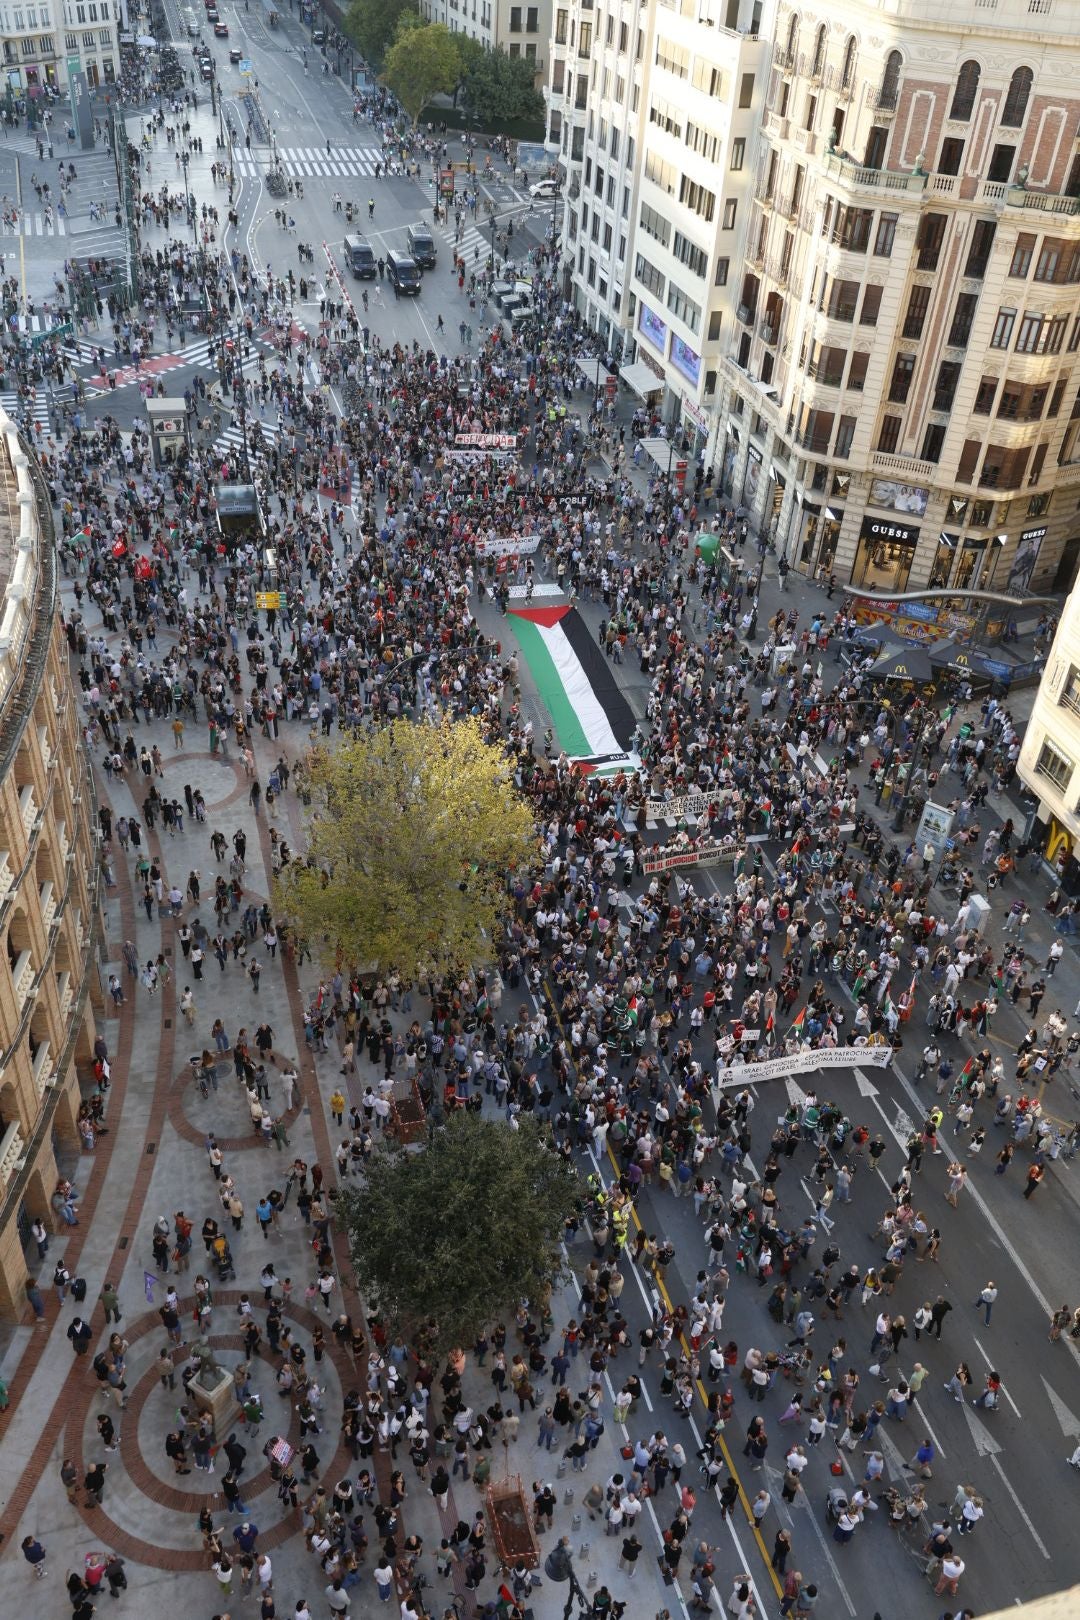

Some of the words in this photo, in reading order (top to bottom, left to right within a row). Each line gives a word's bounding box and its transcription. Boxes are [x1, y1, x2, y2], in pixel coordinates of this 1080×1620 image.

[871, 524, 908, 539] GUESS
[1022, 529, 1046, 540] GUESS
[706, 792, 720, 800] PER
[645, 863, 655, 872] FIN
[721, 845, 739, 856] ISRAE
[741, 1066, 762, 1075] ISRAEL
